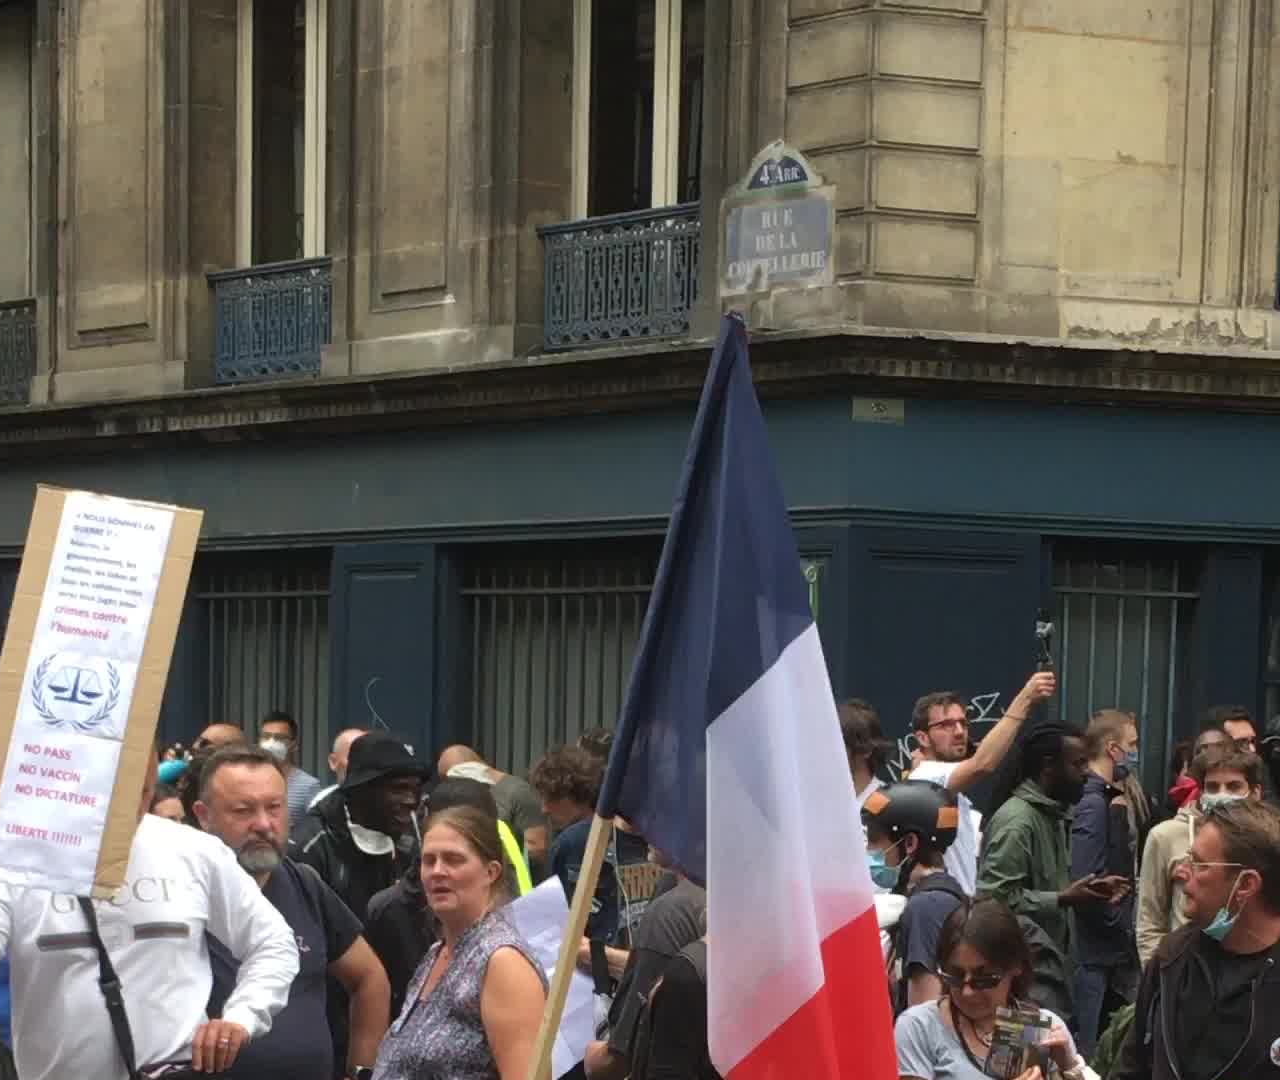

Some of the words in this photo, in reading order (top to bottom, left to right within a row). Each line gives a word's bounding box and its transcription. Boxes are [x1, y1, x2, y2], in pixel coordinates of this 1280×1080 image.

[54, 605, 89, 618] crimes
[92, 611, 128, 624] contre
[23, 743, 41, 753] NO
[43, 745, 72, 761] PASS
[19, 763, 37, 775] NO
[41, 767, 81, 784] VACCIN
[15, 784, 33, 796] NO
[35, 787, 97, 808] DICTATURE
